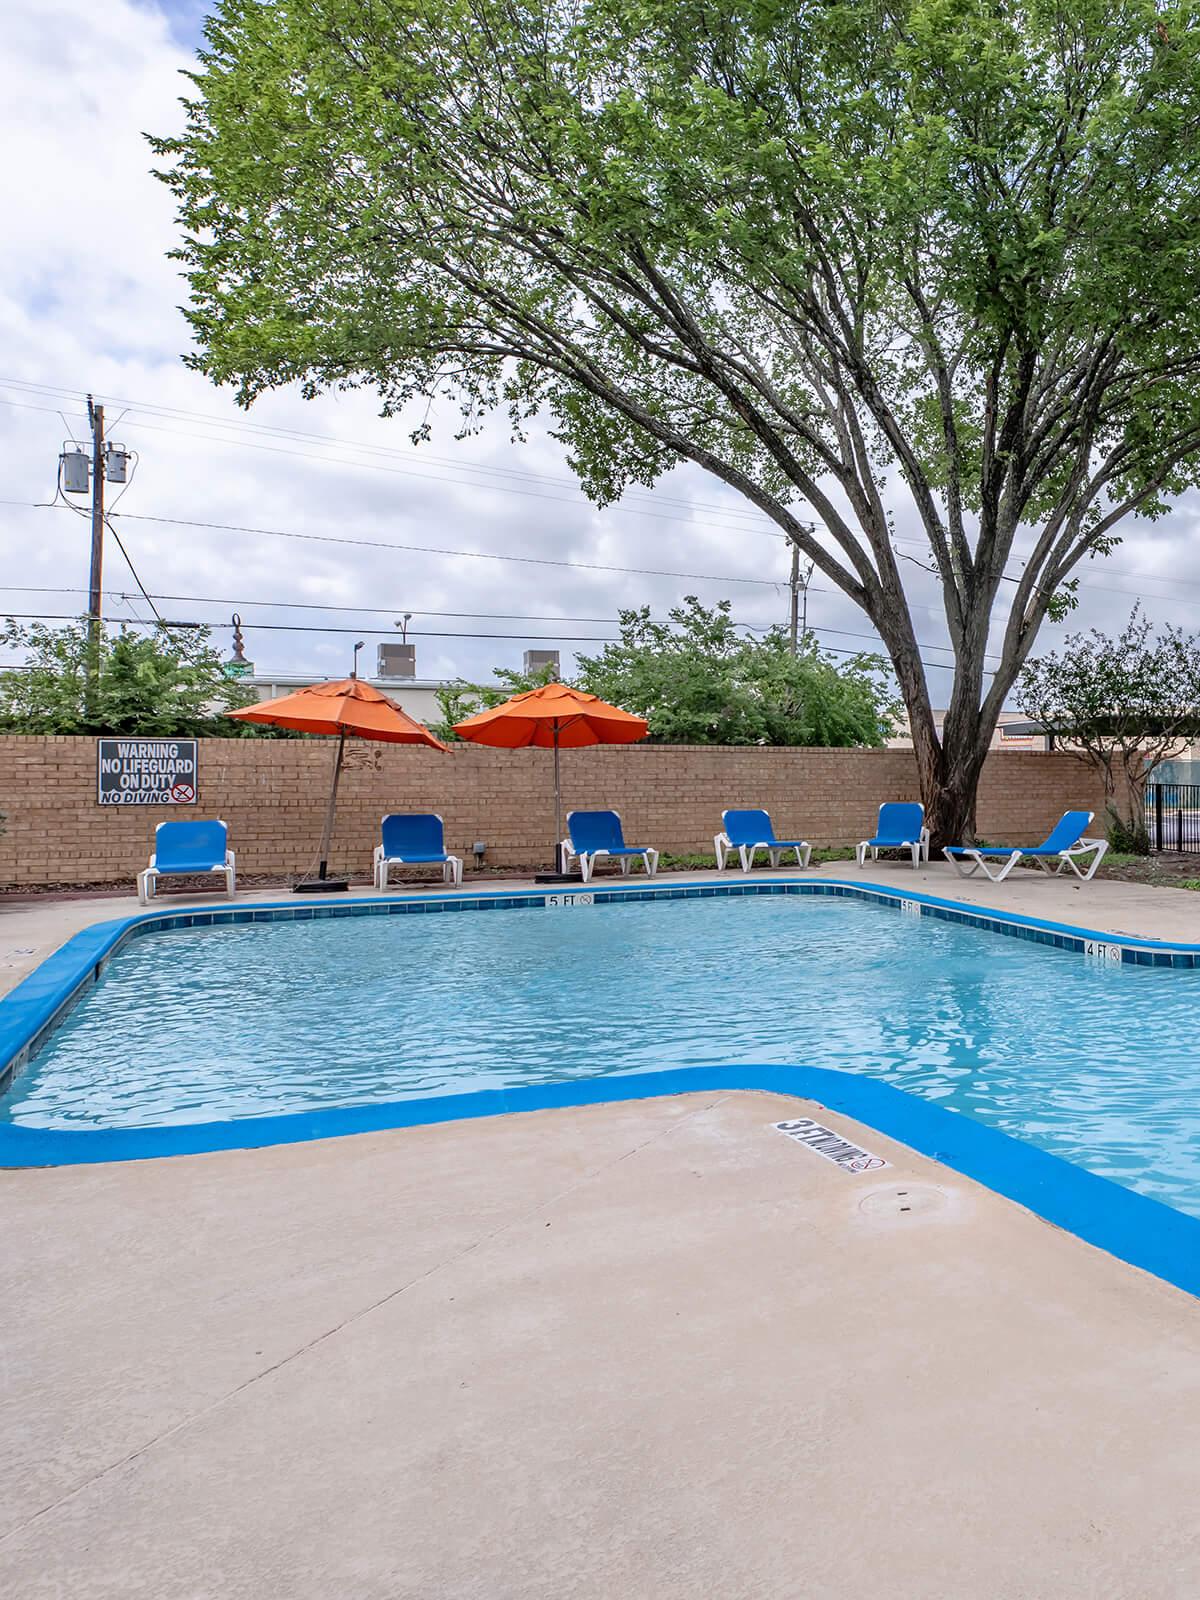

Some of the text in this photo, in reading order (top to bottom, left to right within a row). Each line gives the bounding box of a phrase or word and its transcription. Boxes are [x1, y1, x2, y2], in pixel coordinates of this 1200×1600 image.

[117, 743, 179, 758] WARNING
[102, 759, 193, 773] NO LIFEGUARD
[120, 774, 176, 788] ON DUTY
[101, 792, 170, 803] NO DIVING
[550, 895, 576, 906] 5 FT
[1087, 943, 1107, 960] 4 FT
[777, 1120, 815, 1131] 3
